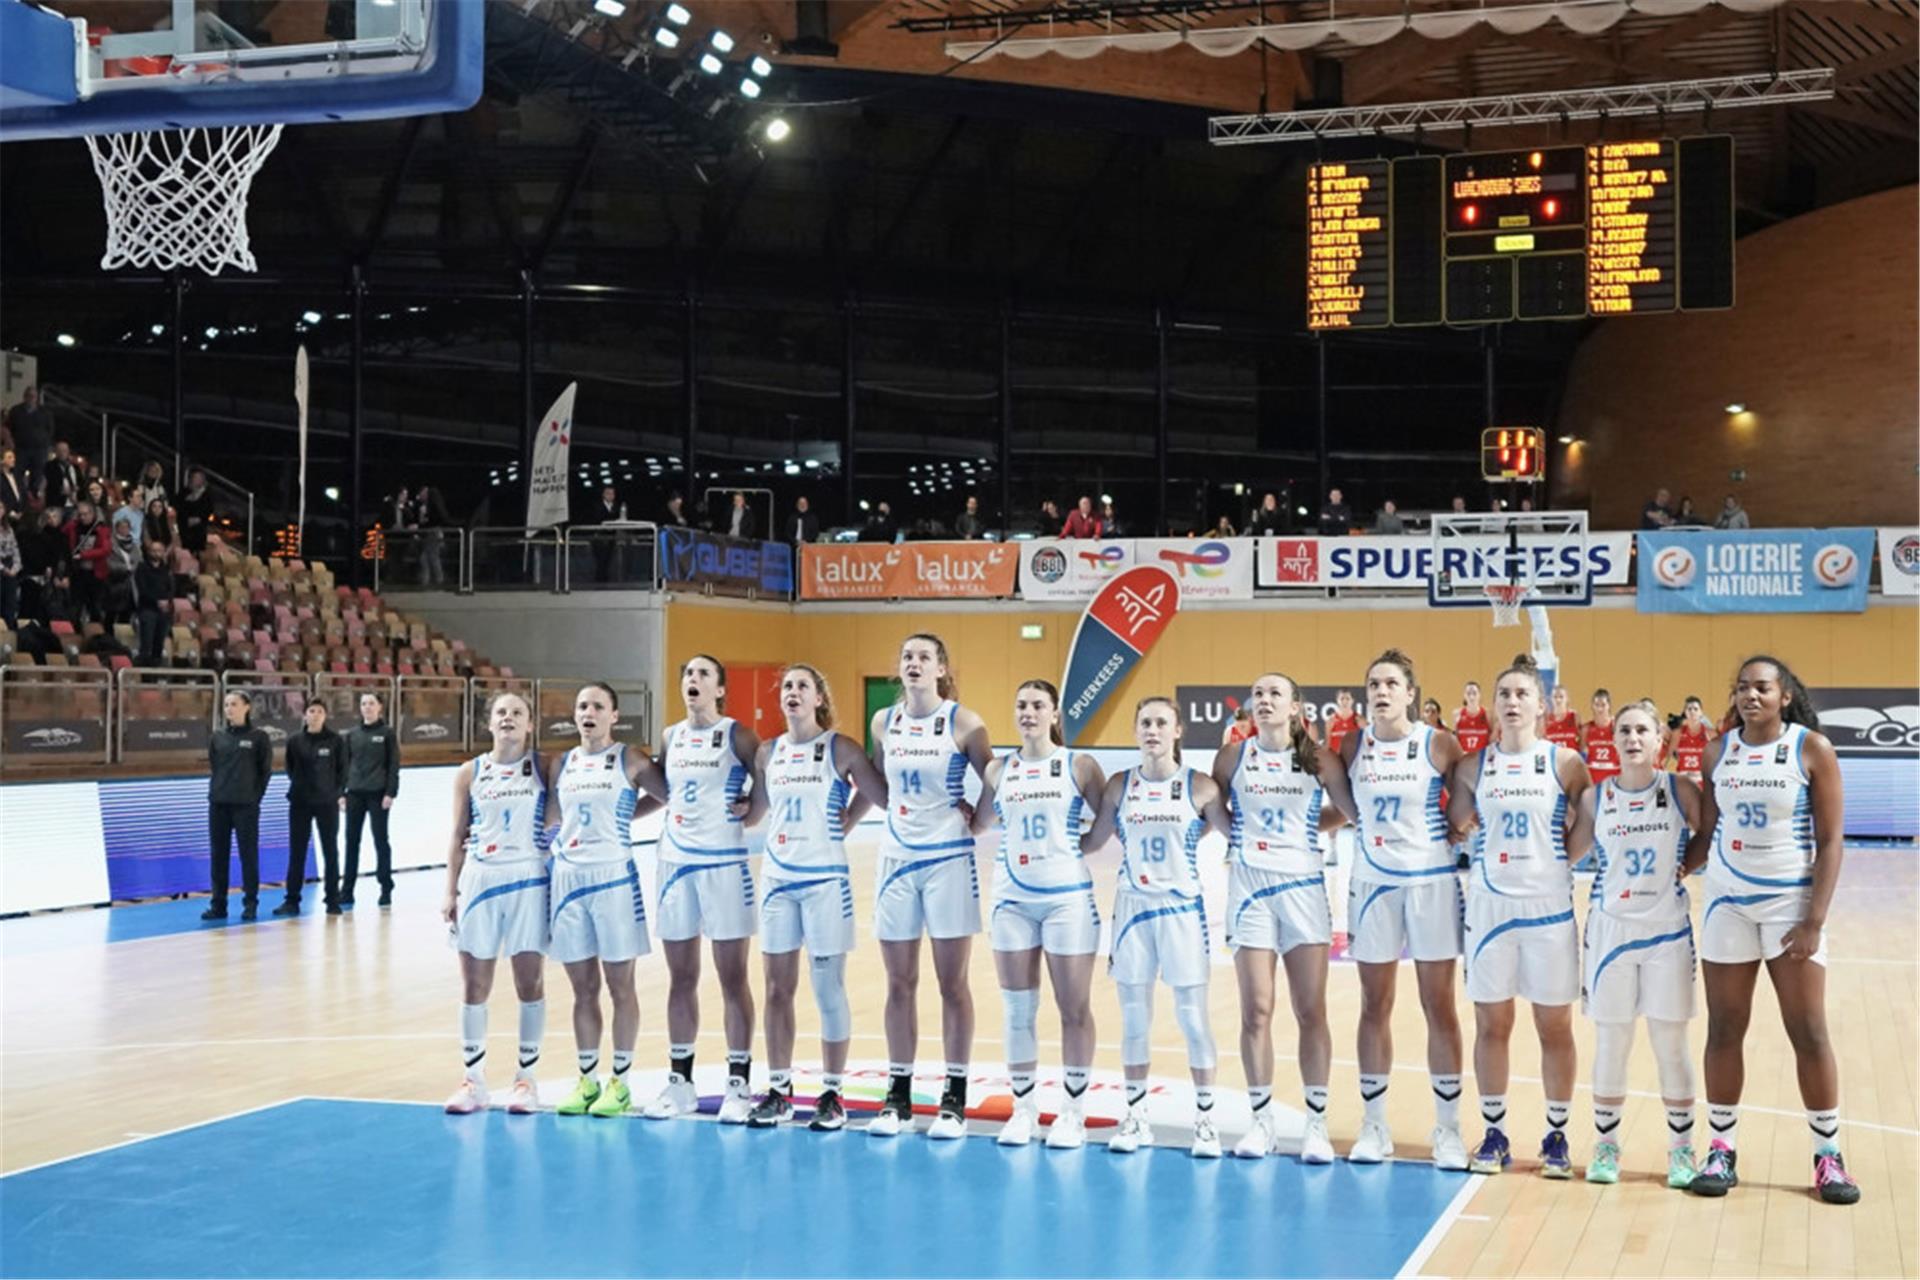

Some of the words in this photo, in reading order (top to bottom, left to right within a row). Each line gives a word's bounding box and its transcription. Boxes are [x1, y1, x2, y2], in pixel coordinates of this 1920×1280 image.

[6, 352, 24, 393] F
[816, 556, 883, 582] lalux
[917, 553, 986, 580] lalux
[1330, 546, 1612, 580] SPUERKEESS
[1707, 543, 1803, 573] LOTERIE
[1707, 575, 1803, 596] NATIONALE
[1068, 653, 1124, 719] SPUERKEESS
[1466, 738, 1479, 749] 17
[1596, 748, 1610, 760] 22
[901, 769, 922, 794] 14
[501, 808, 510, 833] 1
[579, 803, 591, 826] 5
[784, 797, 802, 822] 11
[1373, 796, 1401, 821] 27
[1736, 802, 1767, 828] 35
[1022, 814, 1046, 840] 16
[1502, 811, 1528, 838] 28
[1141, 837, 1165, 862] 19
[1625, 848, 1656, 876] 32
